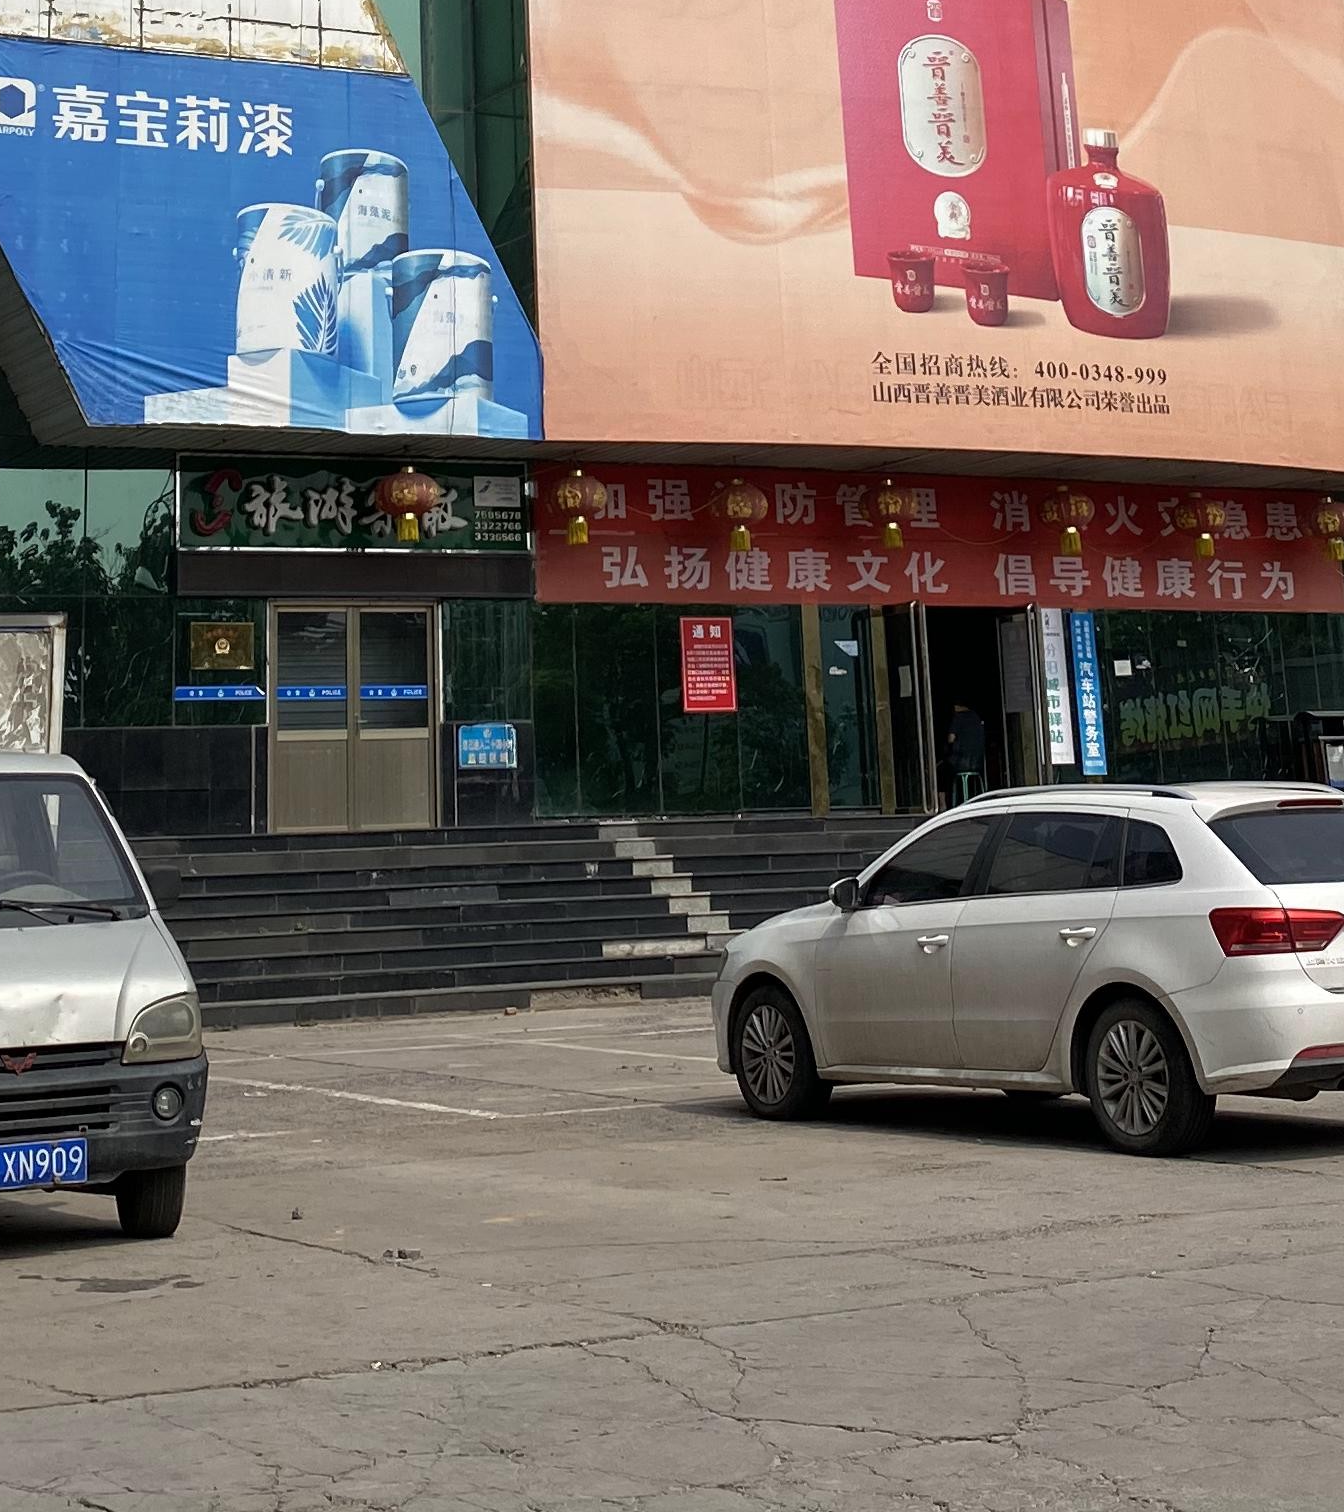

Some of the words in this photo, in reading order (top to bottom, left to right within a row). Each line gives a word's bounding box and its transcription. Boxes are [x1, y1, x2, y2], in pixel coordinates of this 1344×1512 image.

[52, 85, 293, 158] 嘉宝莉漆
[872, 382, 1170, 414] 山西晋善晋美酒业有限公司荣誉出品
[547, 478, 940, 529] 加强防管理
[990, 490, 1303, 542] 消火隐患
[602, 545, 948, 594] 弘扬健康文化
[994, 554, 1295, 602] 倡导健康行为
[692, 624, 721, 639] 通知
[1079, 661, 1100, 758] 汽车站警务室
